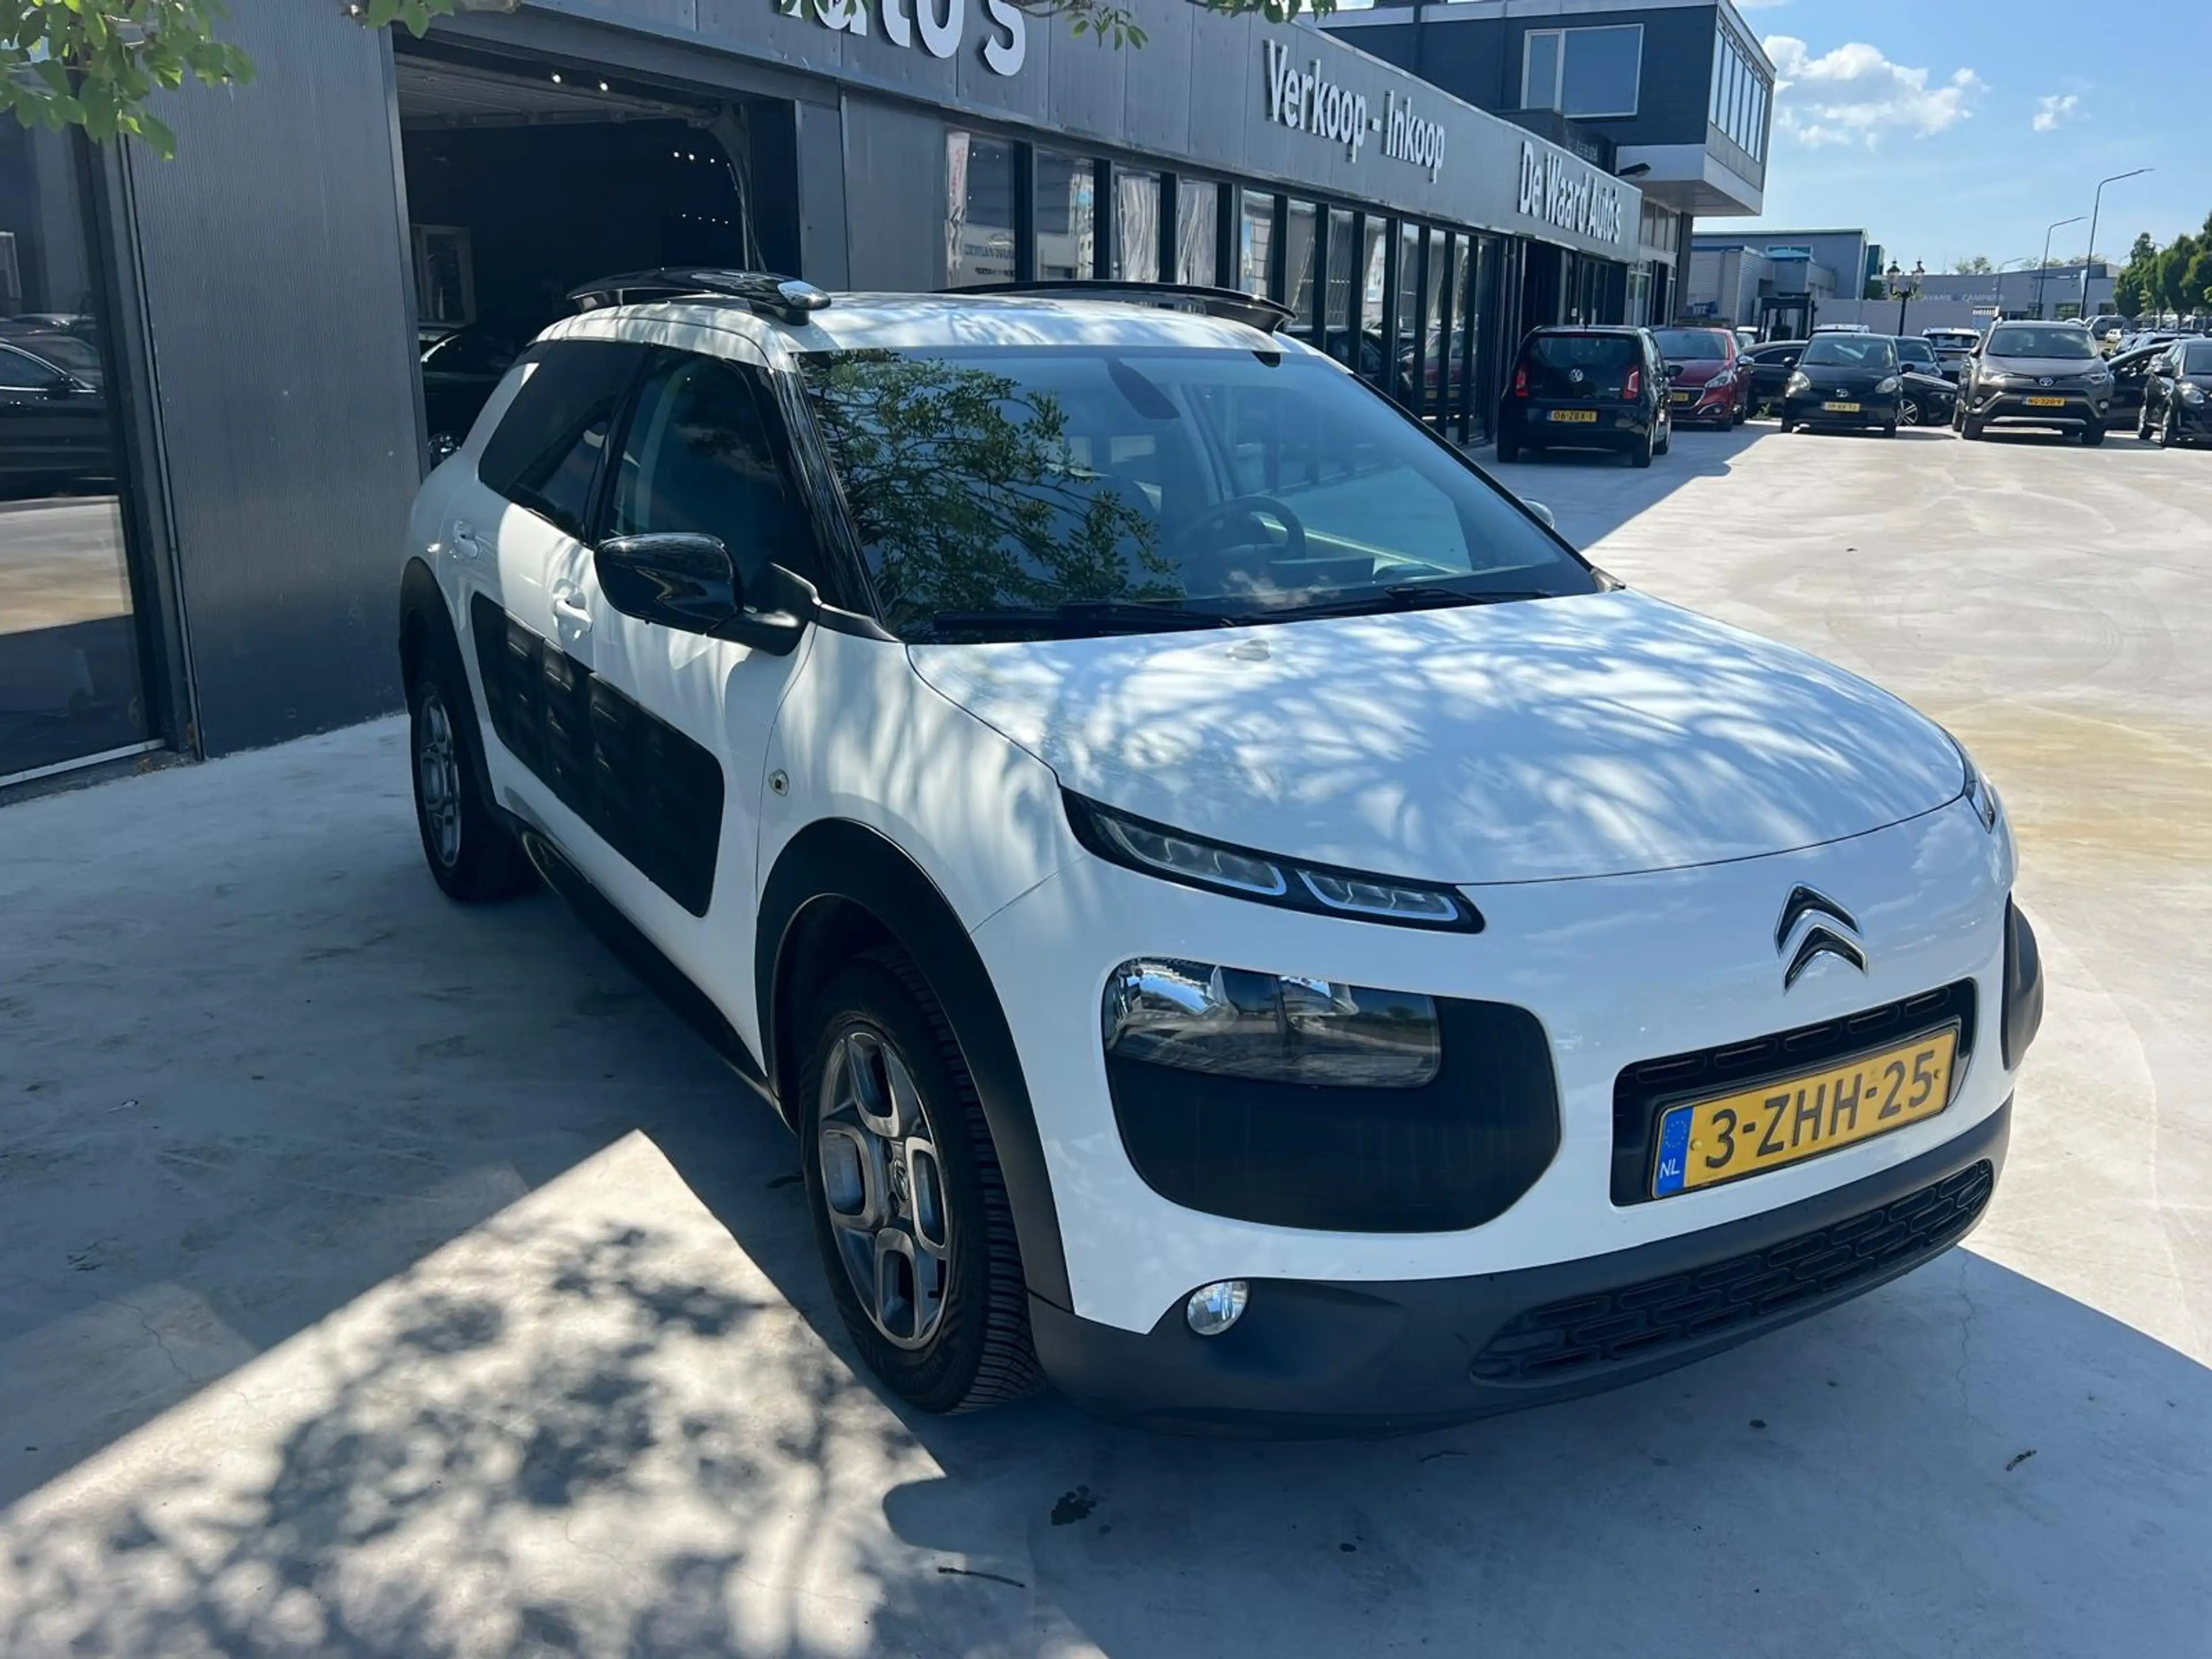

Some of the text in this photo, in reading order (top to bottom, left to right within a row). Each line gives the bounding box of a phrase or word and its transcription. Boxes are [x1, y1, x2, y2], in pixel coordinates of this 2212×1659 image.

[1269, 39, 1366, 164] Verkoop
[1386, 89, 1445, 184] Inkoop
[1519, 140, 1622, 244] De Waard Auto's
[1659, 1049, 1935, 1179] NL 3-ZHH-25
